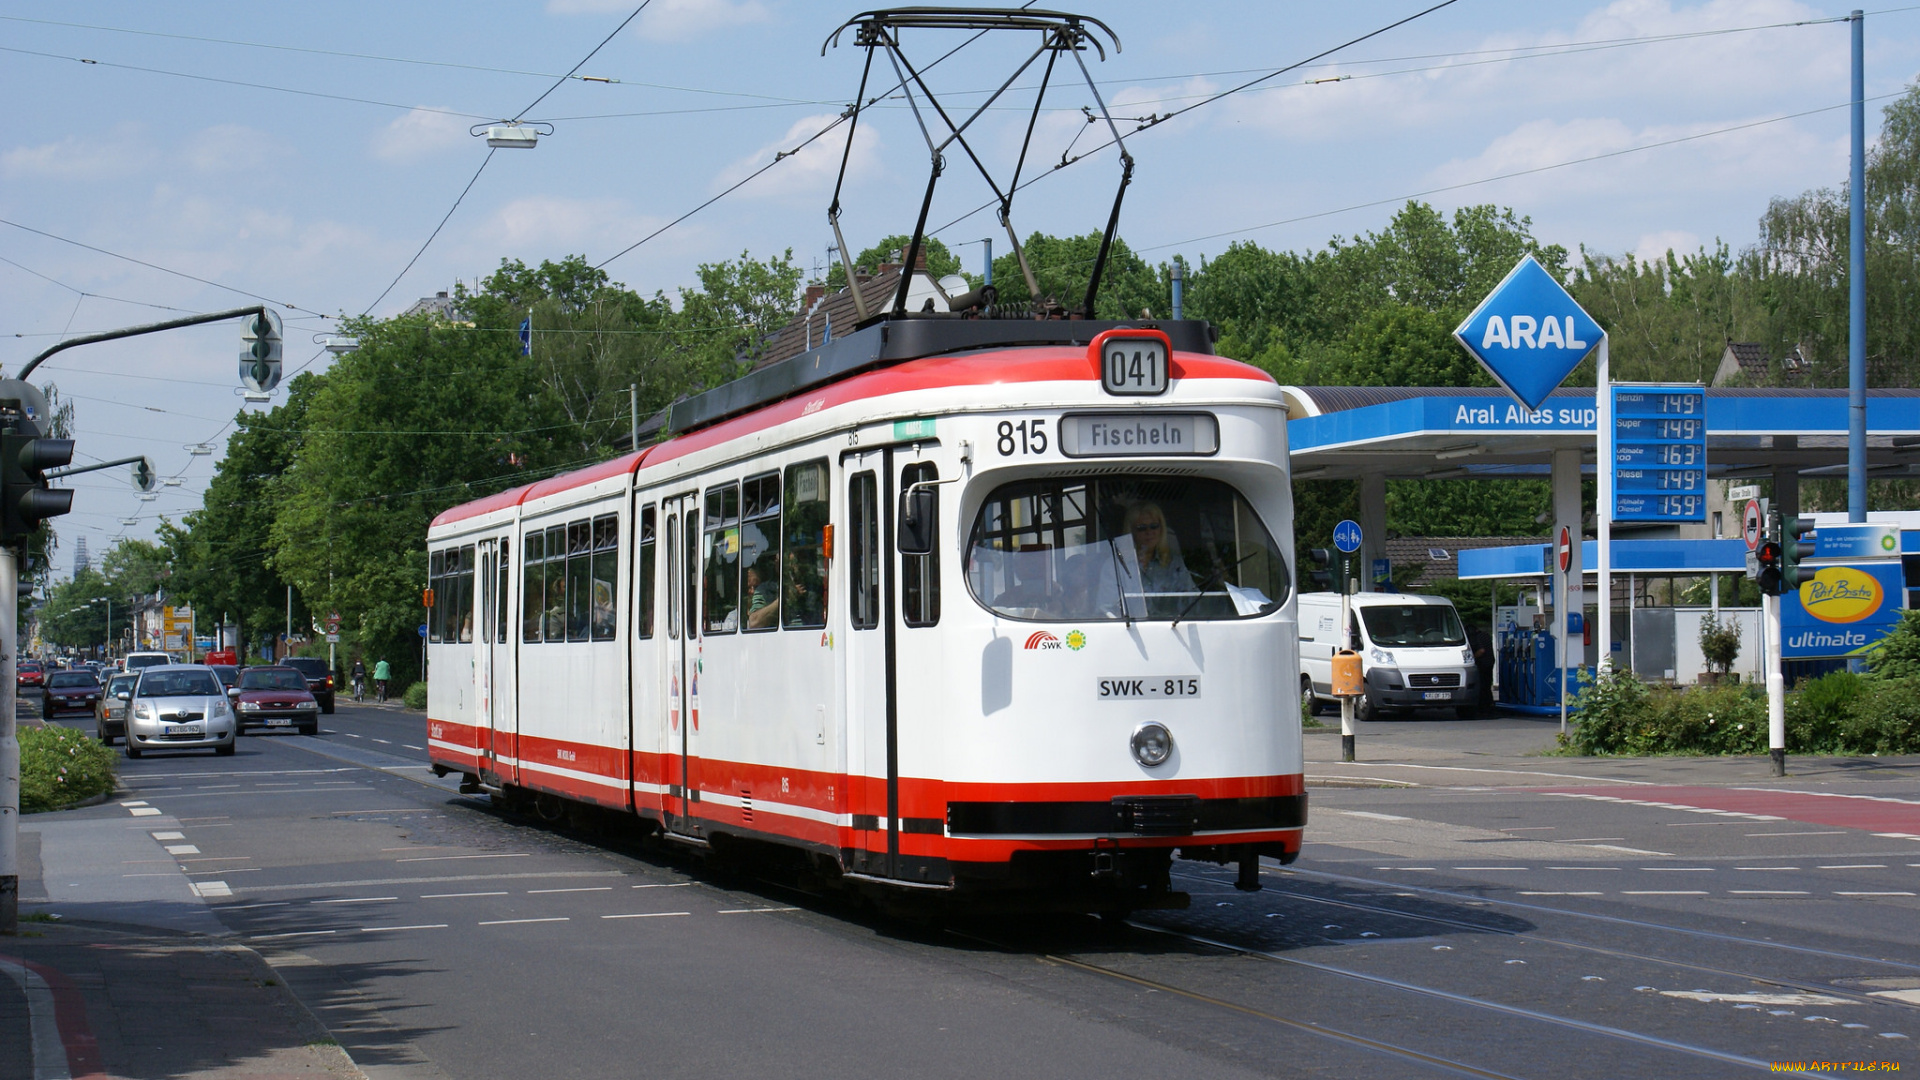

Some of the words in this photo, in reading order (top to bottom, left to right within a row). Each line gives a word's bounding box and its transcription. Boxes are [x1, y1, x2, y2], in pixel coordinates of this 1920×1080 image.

[1482, 315, 1587, 350] ARAL
[1110, 351, 1157, 387] 041
[1455, 404, 1500, 424] Aral.
[1616, 419, 1642, 429] Super
[848, 429, 859, 446] 815
[996, 419, 1048, 456] 815
[1091, 422, 1181, 447] Fischeln
[1616, 470, 1643, 478] Diesel
[1833, 579, 1872, 599] Bistro
[1042, 641, 1063, 650] SWK
[1788, 630, 1866, 648] ultimate
[1099, 680, 1144, 696] SWK
[1163, 679, 1198, 696] 815
